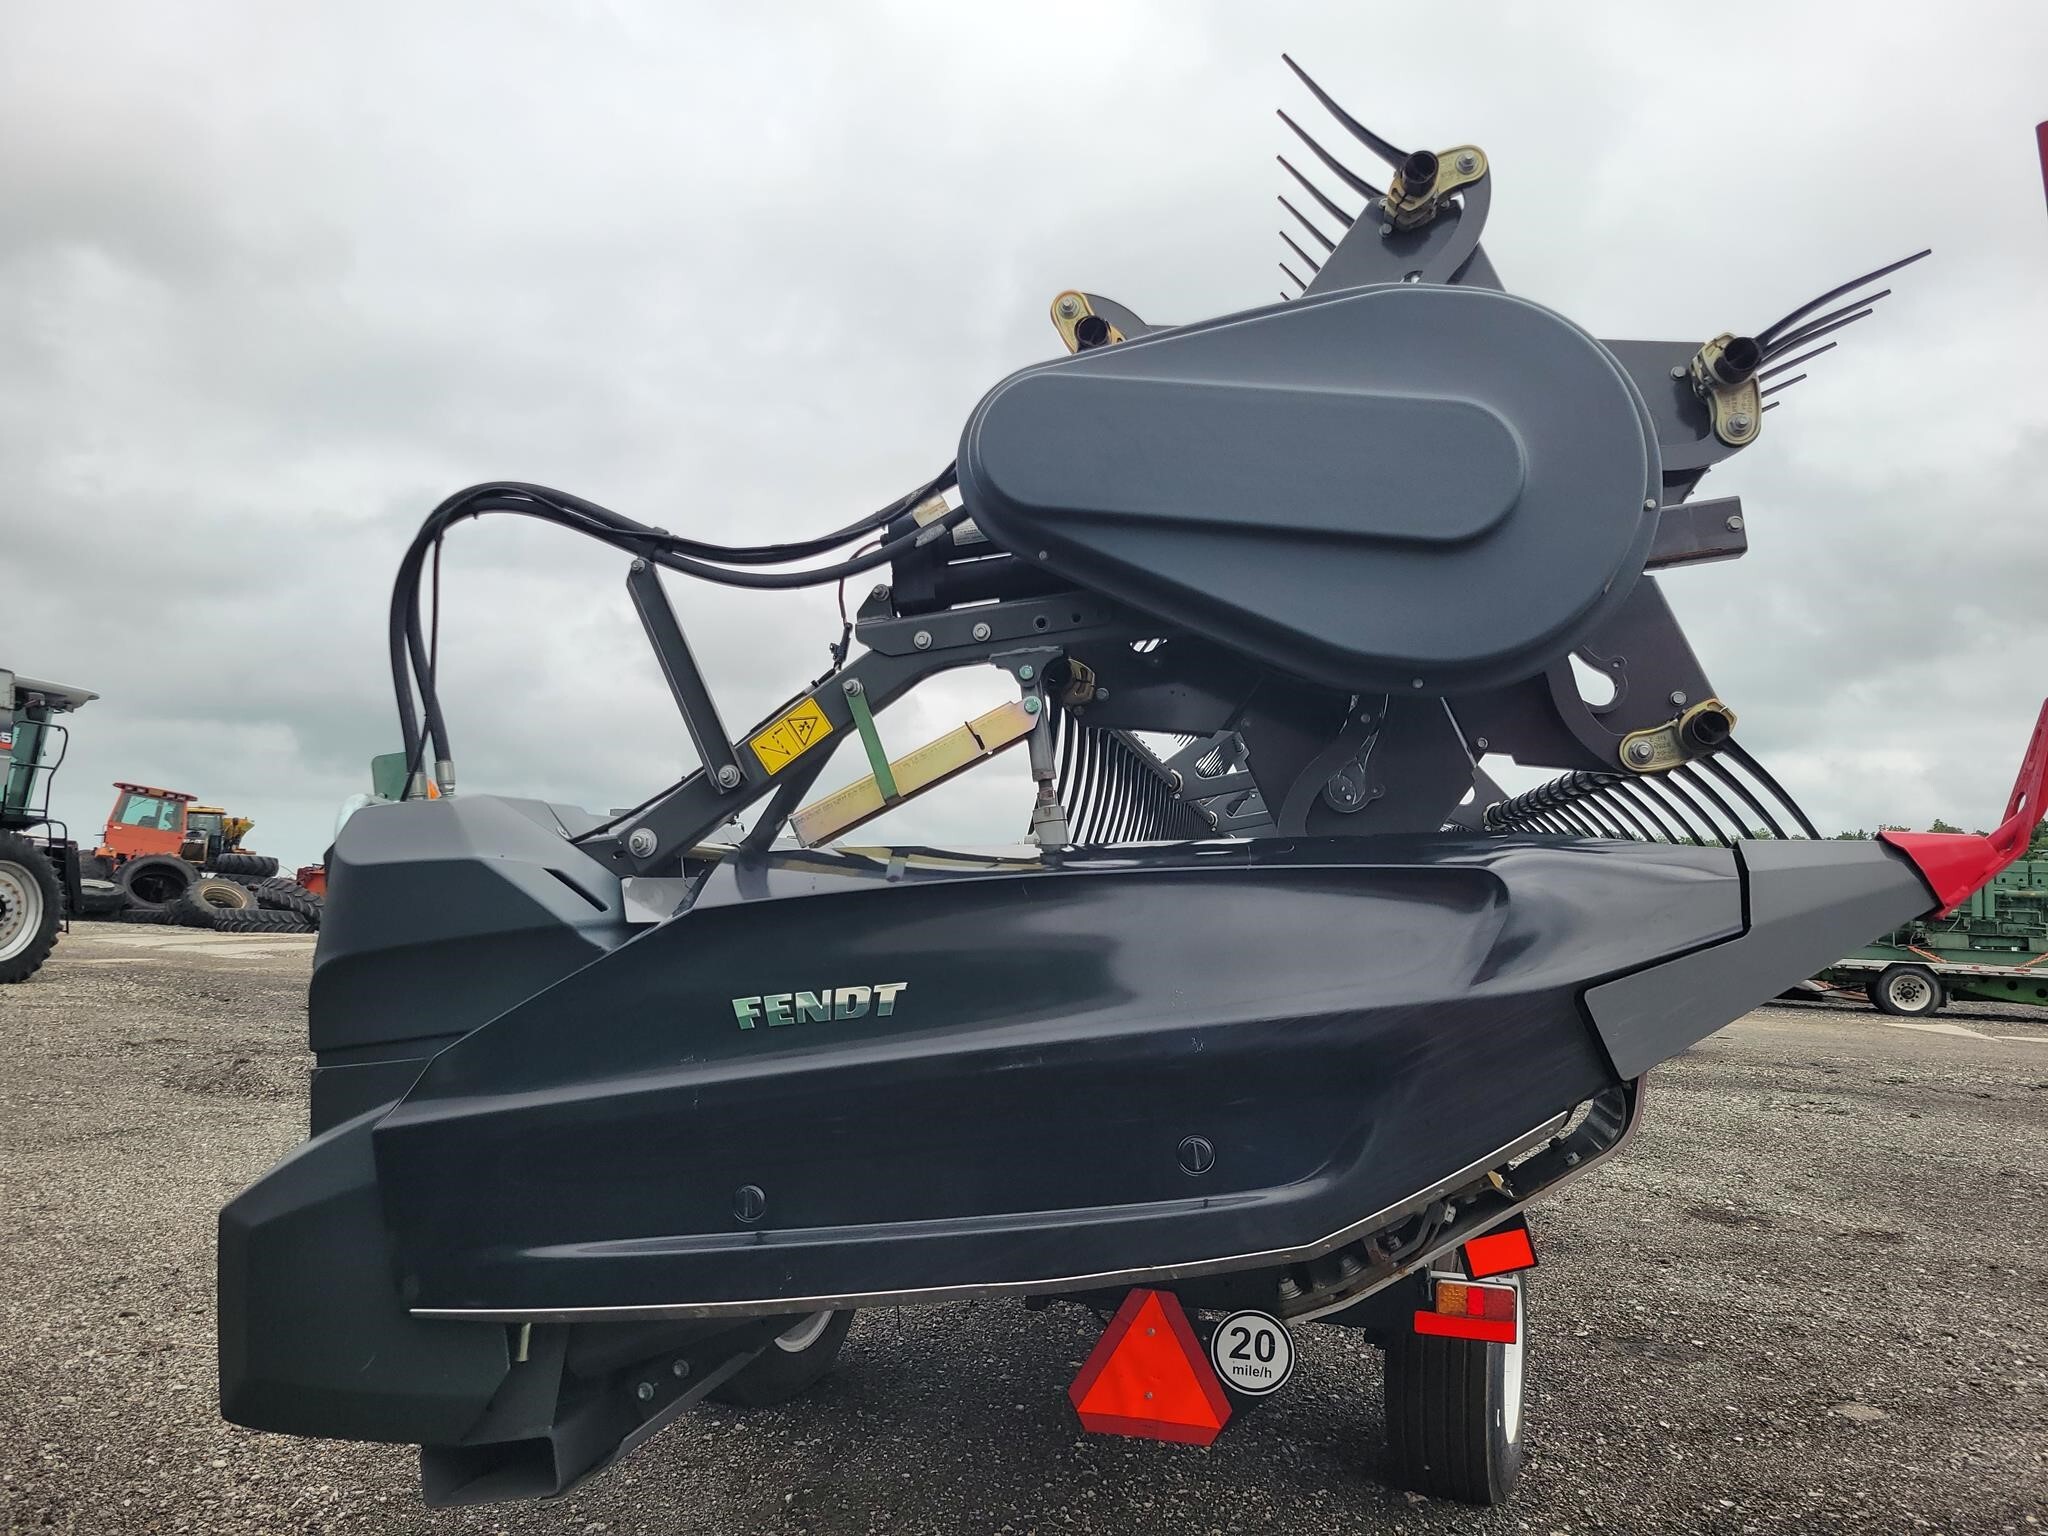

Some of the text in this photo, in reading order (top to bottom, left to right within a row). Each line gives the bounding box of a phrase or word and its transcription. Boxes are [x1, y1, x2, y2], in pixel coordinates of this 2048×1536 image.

[0, 732, 12, 743] 5
[732, 982, 908, 1030] FENDT
[1229, 1326, 1275, 1363] 20
[1232, 1365, 1272, 1378] mile/h
